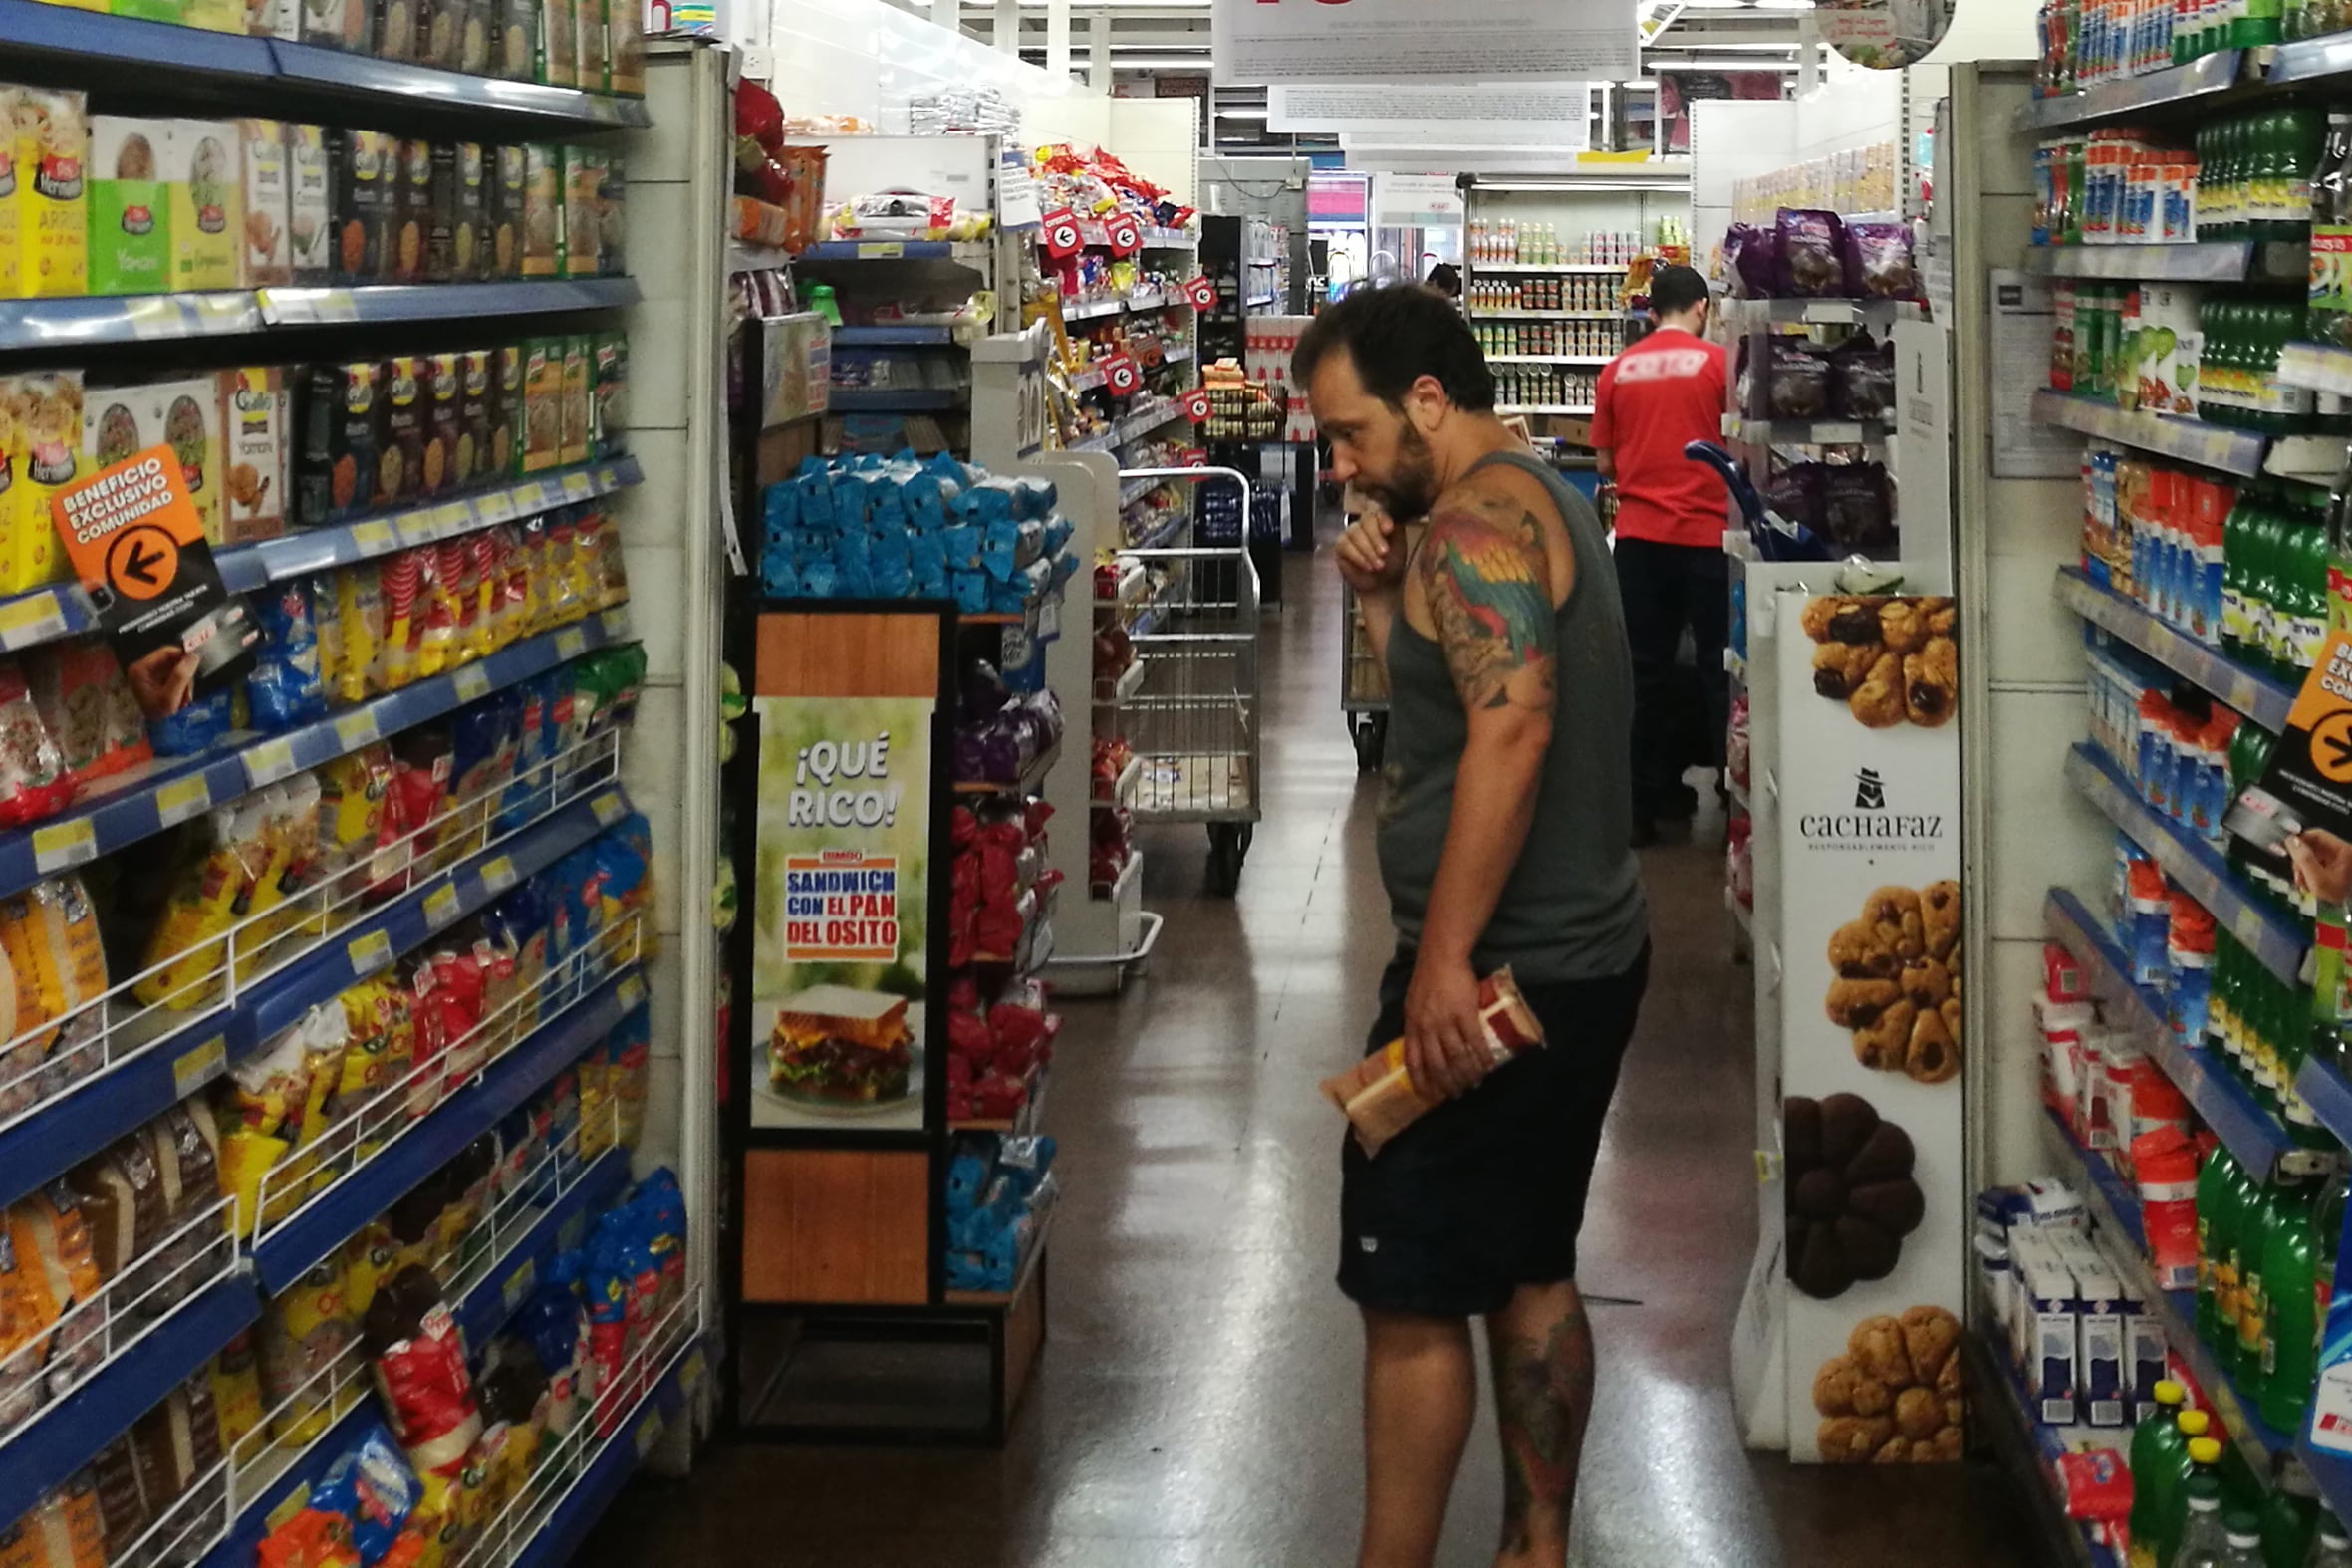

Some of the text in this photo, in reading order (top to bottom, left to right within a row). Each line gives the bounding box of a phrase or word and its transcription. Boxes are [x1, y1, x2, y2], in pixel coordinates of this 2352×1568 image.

[63, 457, 161, 513] BENEFICIO
[69, 474, 167, 530] EXCLUSIVO
[77, 491, 173, 544] COMUNIDAD
[796, 730, 890, 787] ¡QUÉ
[788, 786, 899, 828] RICO!
[787, 871, 895, 894] SANDWICH
[787, 895, 895, 917] CON EL PAN
[787, 920, 897, 946] DEL OSITO
